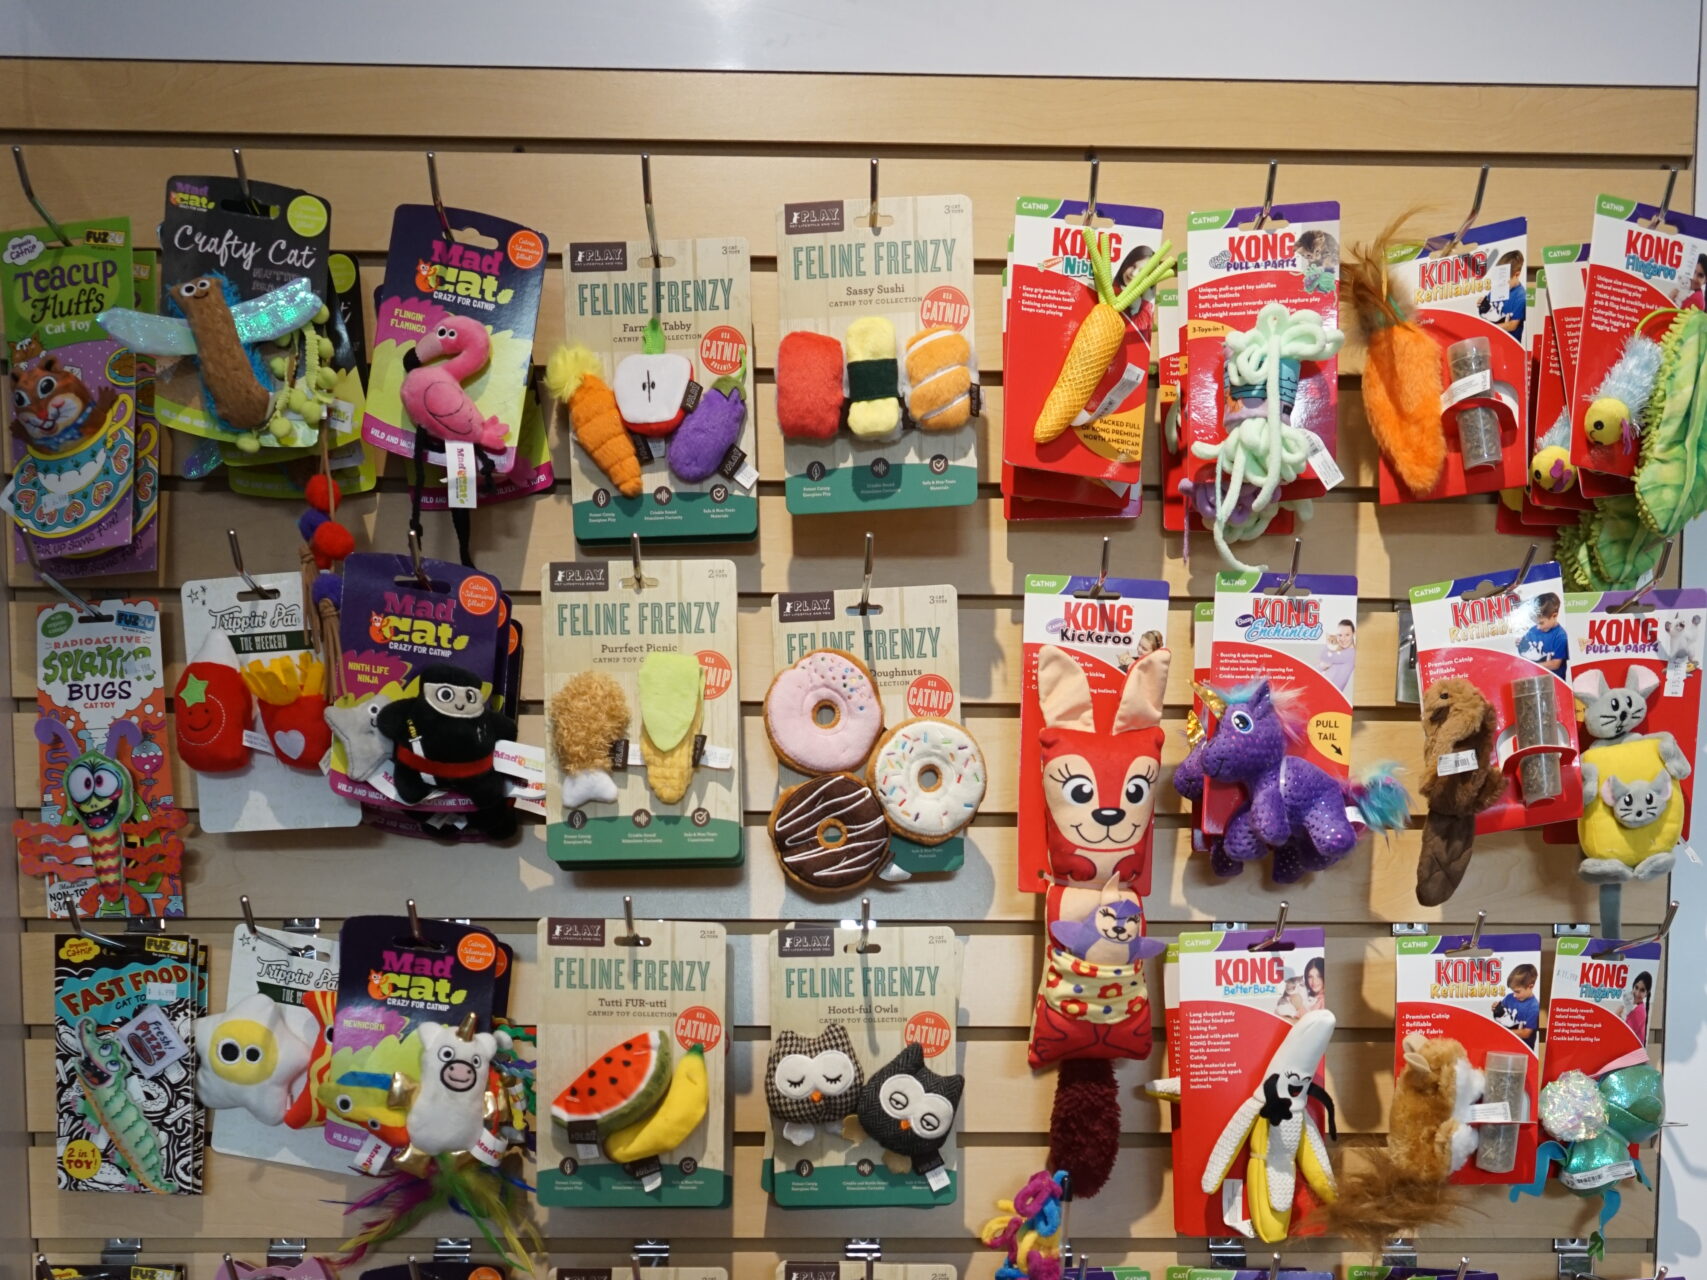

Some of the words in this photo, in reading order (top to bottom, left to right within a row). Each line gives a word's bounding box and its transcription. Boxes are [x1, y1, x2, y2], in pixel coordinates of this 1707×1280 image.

[1022, 202, 1049, 210] CATNIP
[1601, 201, 1624, 213] CATNIP
[1192, 216, 1219, 225] CATNIP
[174, 224, 262, 269] Crafty
[268, 238, 316, 271] Cat
[1228, 232, 1296, 261] KONG
[1625, 230, 1683, 270] KONG
[431, 239, 504, 278] Mad
[793, 243, 866, 280] FELINE
[874, 238, 956, 275] FRENZY
[14, 259, 118, 302] Teacup
[1419, 252, 1488, 290] KONG
[578, 282, 648, 316] FELINE
[655, 278, 733, 313] FRENZY
[846, 285, 874, 297] Sassy
[877, 284, 905, 294] Sushi
[1415, 277, 1491, 304] Refillables
[30, 291, 105, 325] Fluffs
[394, 308, 426, 322] FLINGIN'
[829, 300, 856, 308] CATNIP
[921, 304, 968, 324] CATNIP
[45, 321, 65, 335] Cat
[67, 319, 91, 334] Toy
[390, 318, 426, 333] FLAMINGO
[663, 321, 691, 334] Tabby
[1092, 426, 1110, 434] KONG
[1112, 428, 1141, 438] PREMIUM
[1100, 418, 1124, 428] PACKED
[1084, 433, 1106, 442] NORTH
[1106, 437, 1139, 447] AMERICAN
[1030, 579, 1057, 588] CATNIP
[1221, 578, 1247, 588] CATNIP
[384, 592, 457, 623] Mad
[1064, 602, 1133, 632] KONG
[1252, 598, 1319, 627] KONG
[558, 604, 631, 636] FELINE
[639, 602, 719, 634] FRENZY
[254, 634, 287, 650] WEEKEND
[1588, 618, 1659, 644] KONG
[53, 636, 142, 649] RADIOACTIVE
[413, 644, 426, 654] FOR
[428, 647, 452, 658] CATNIP
[646, 643, 677, 653] Picnic
[864, 627, 940, 660] FRENZY
[348, 662, 369, 673] NINTH
[371, 665, 389, 675] LIFE
[357, 674, 378, 684] NINJA
[68, 681, 132, 702] BUGS
[909, 686, 952, 709] CATNIP
[1185, 939, 1211, 948] CATNIP
[383, 951, 454, 978] Mad
[554, 958, 625, 990] FELINE
[632, 959, 710, 991] FRENZY
[1215, 957, 1284, 987] KONG
[1435, 959, 1501, 985] KONG
[1580, 963, 1628, 988] KONG
[786, 968, 854, 998] FELINE
[863, 966, 939, 997] FRENZY
[1431, 984, 1505, 999] Refillables
[61, 974, 127, 1017] FAST
[599, 998, 622, 1008] Tutti
[828, 1004, 872, 1014] Hooti-ful
[676, 1019, 721, 1041] CATNIP
[906, 1025, 949, 1048] CATNIP
[135, 1021, 167, 1062] PIZZA
